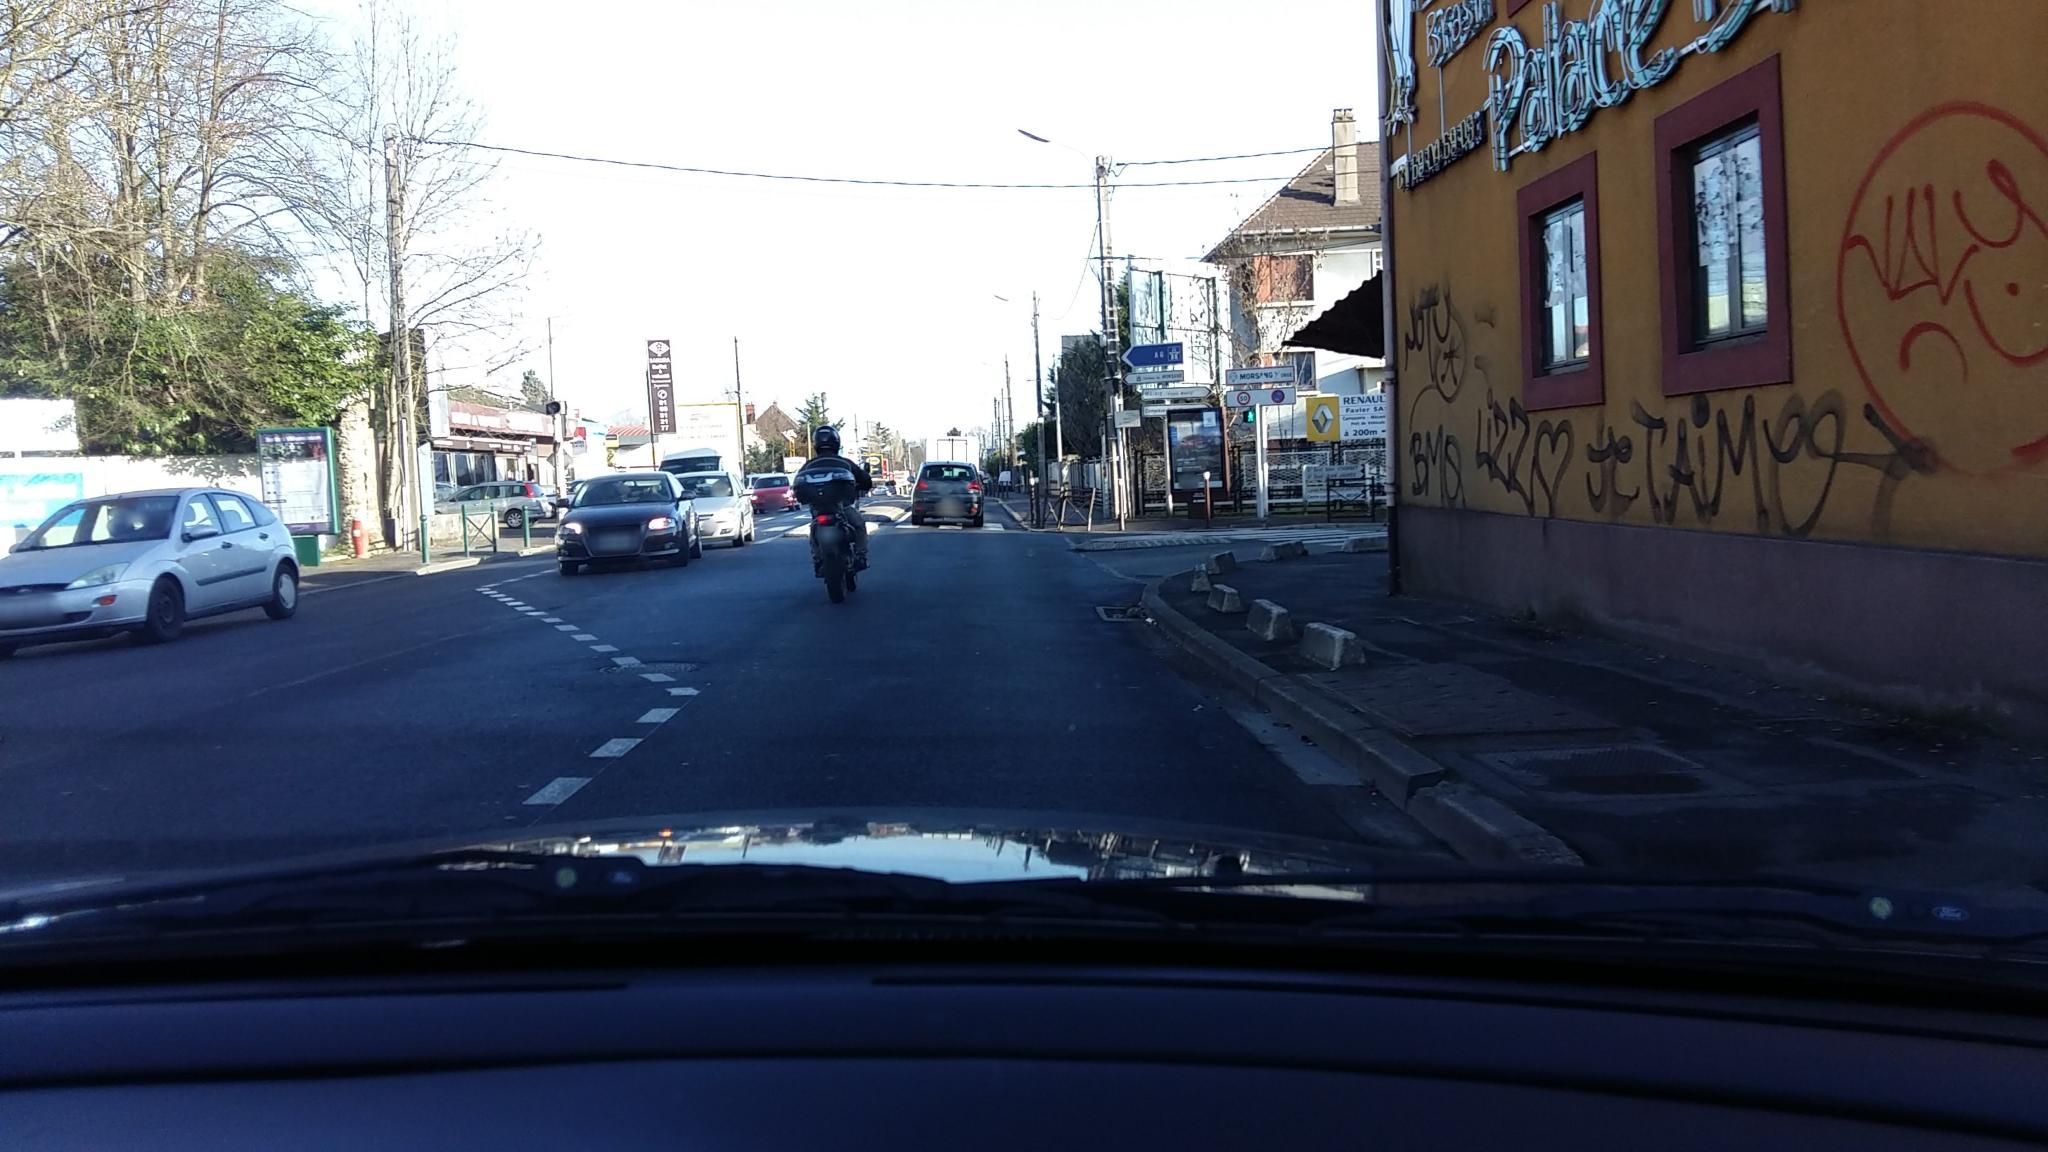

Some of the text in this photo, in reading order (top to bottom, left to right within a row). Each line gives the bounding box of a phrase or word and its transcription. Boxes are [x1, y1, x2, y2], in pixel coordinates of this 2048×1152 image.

[1482, 0, 1680, 172] Palace
[1240, 371, 1273, 380] MORSANG
[1343, 395, 1386, 405] RENAUL
